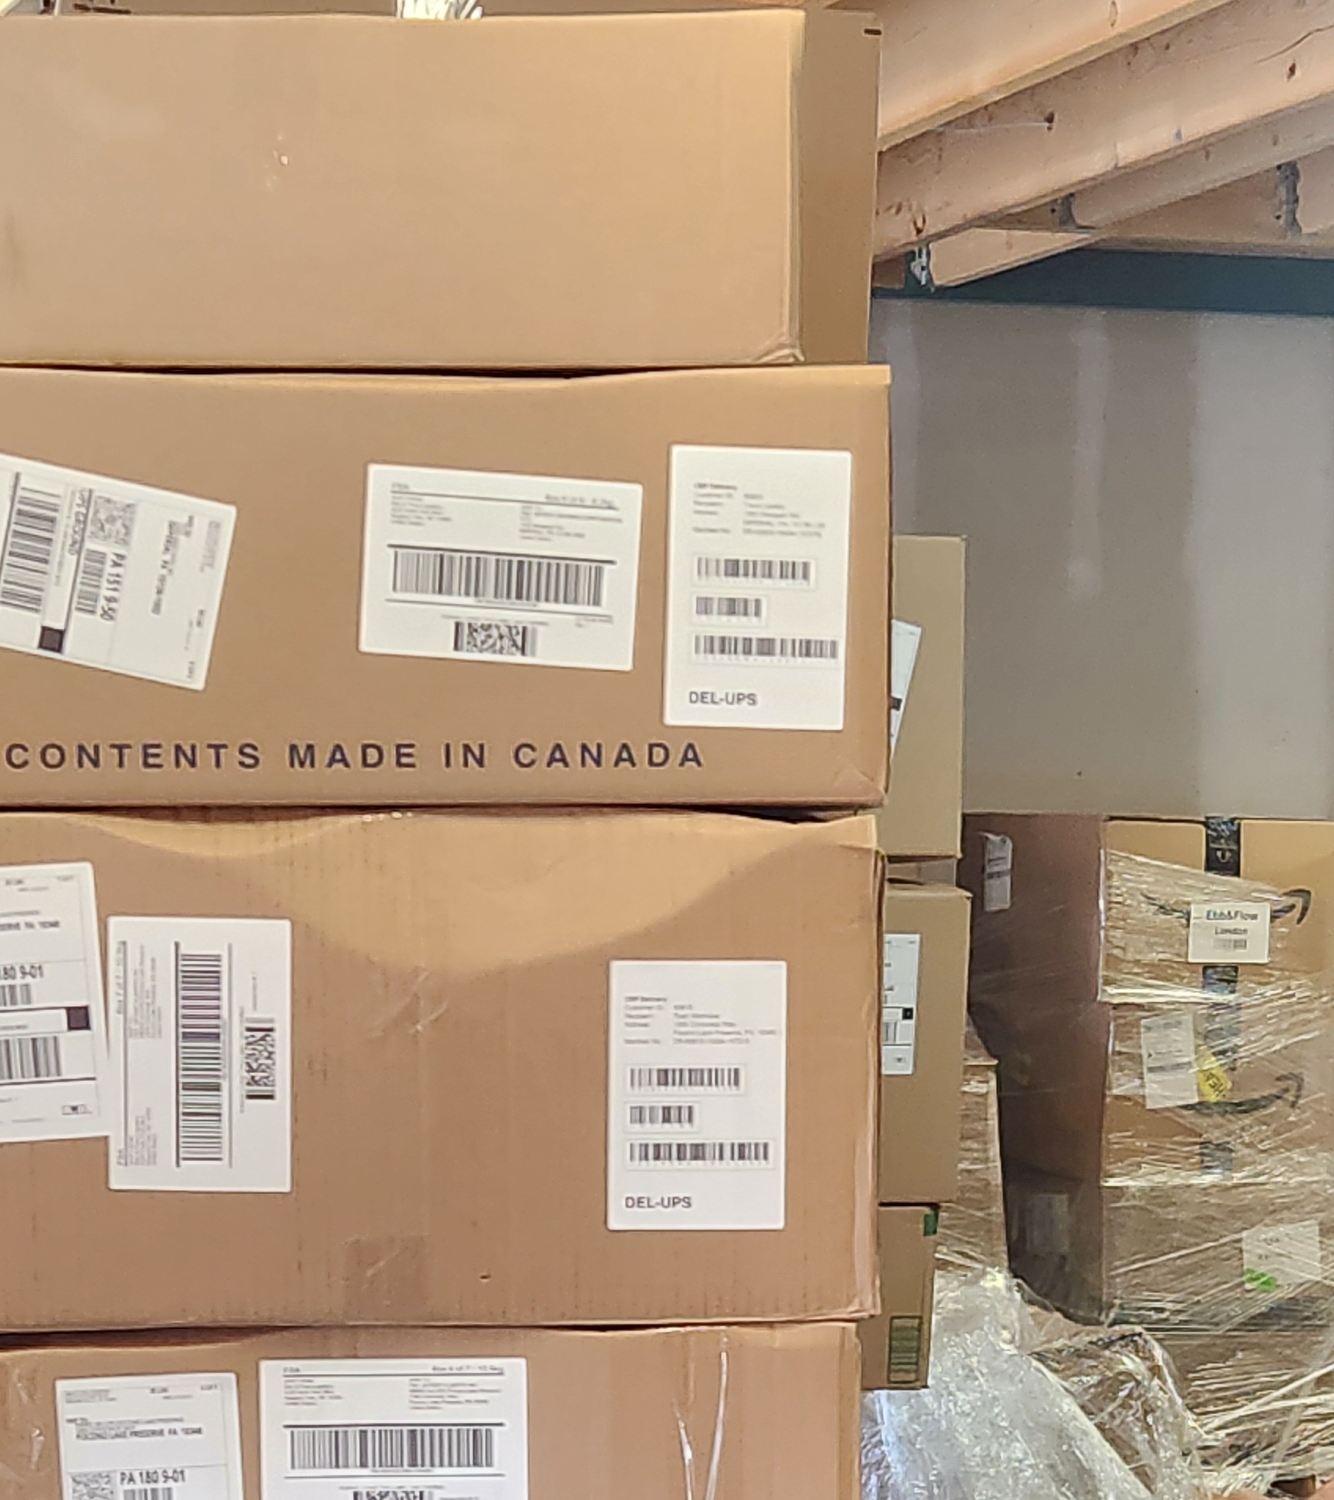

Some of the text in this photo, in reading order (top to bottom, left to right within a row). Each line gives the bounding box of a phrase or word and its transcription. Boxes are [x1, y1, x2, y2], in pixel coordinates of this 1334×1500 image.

[688, 691, 758, 706] DEL-UPS
[6, 742, 702, 769] CONTENTS MADE IN CANADA
[624, 1196, 693, 1209] DEL-UPS
[120, 1471, 136, 1485] PA
